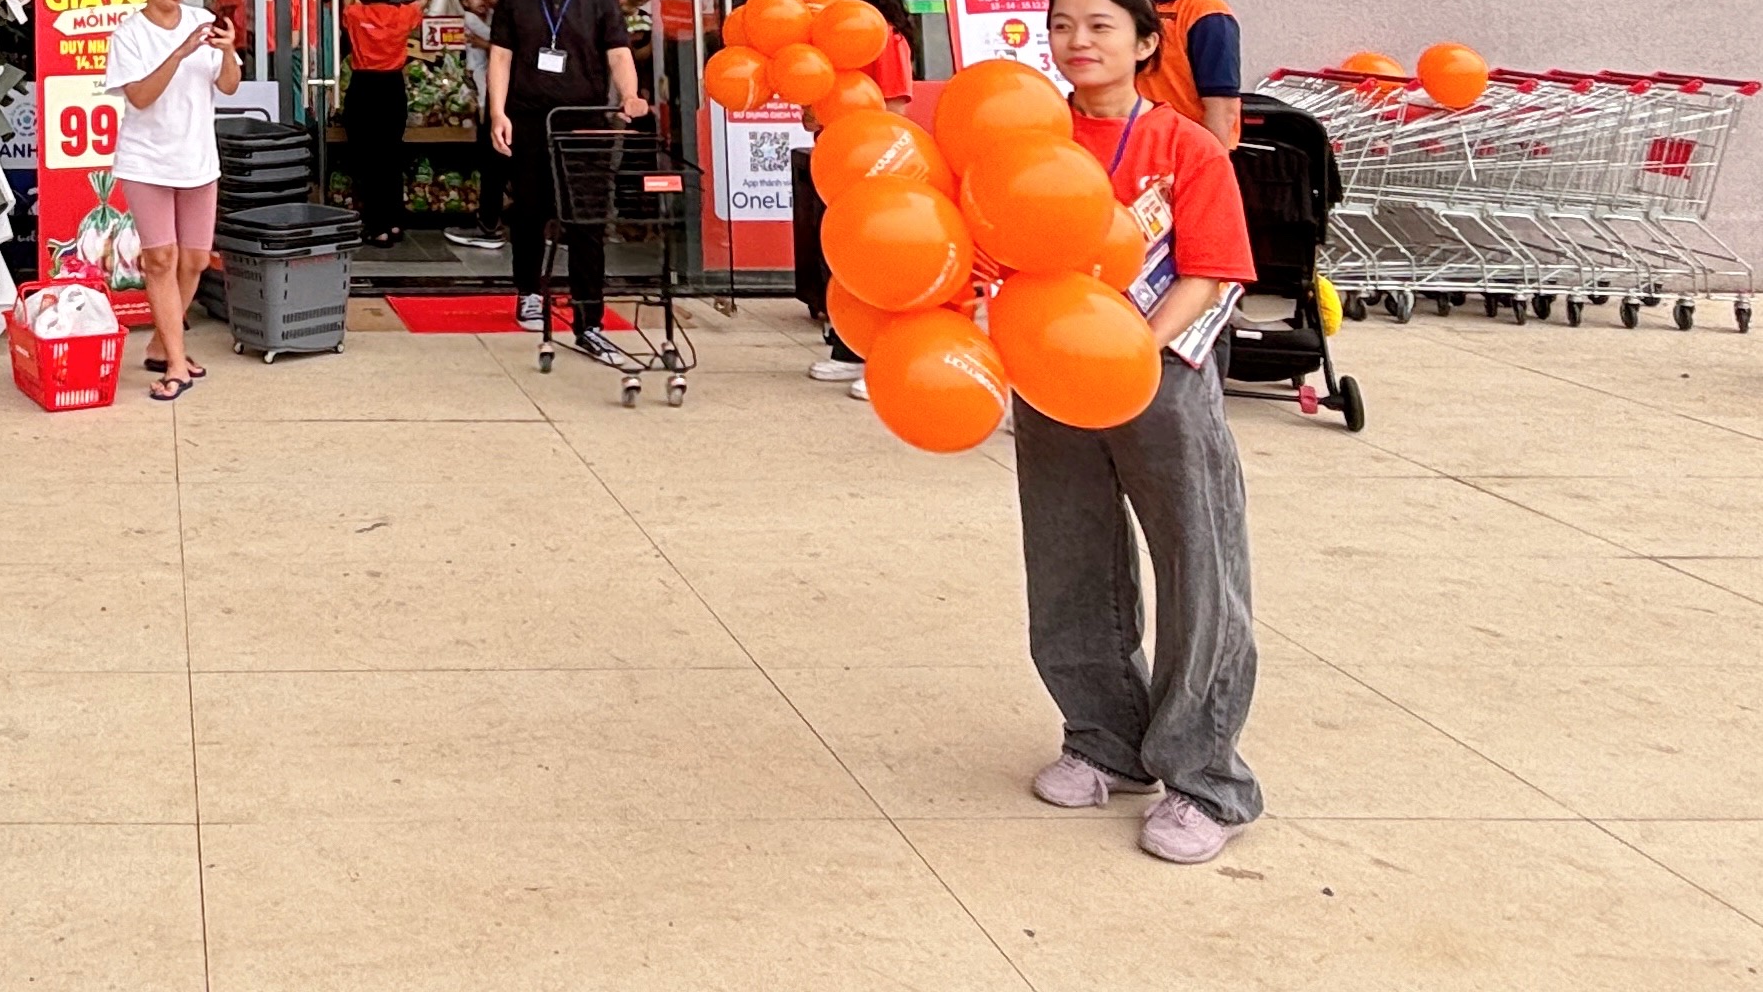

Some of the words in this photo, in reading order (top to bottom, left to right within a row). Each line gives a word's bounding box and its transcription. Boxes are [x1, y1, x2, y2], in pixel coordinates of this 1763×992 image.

[73, 9, 103, 29] MỖI
[60, 40, 85, 54] DUY
[76, 56, 106, 70] 14.12
[743, 179, 758, 187] App
[732, 192, 793, 209] OneLi
